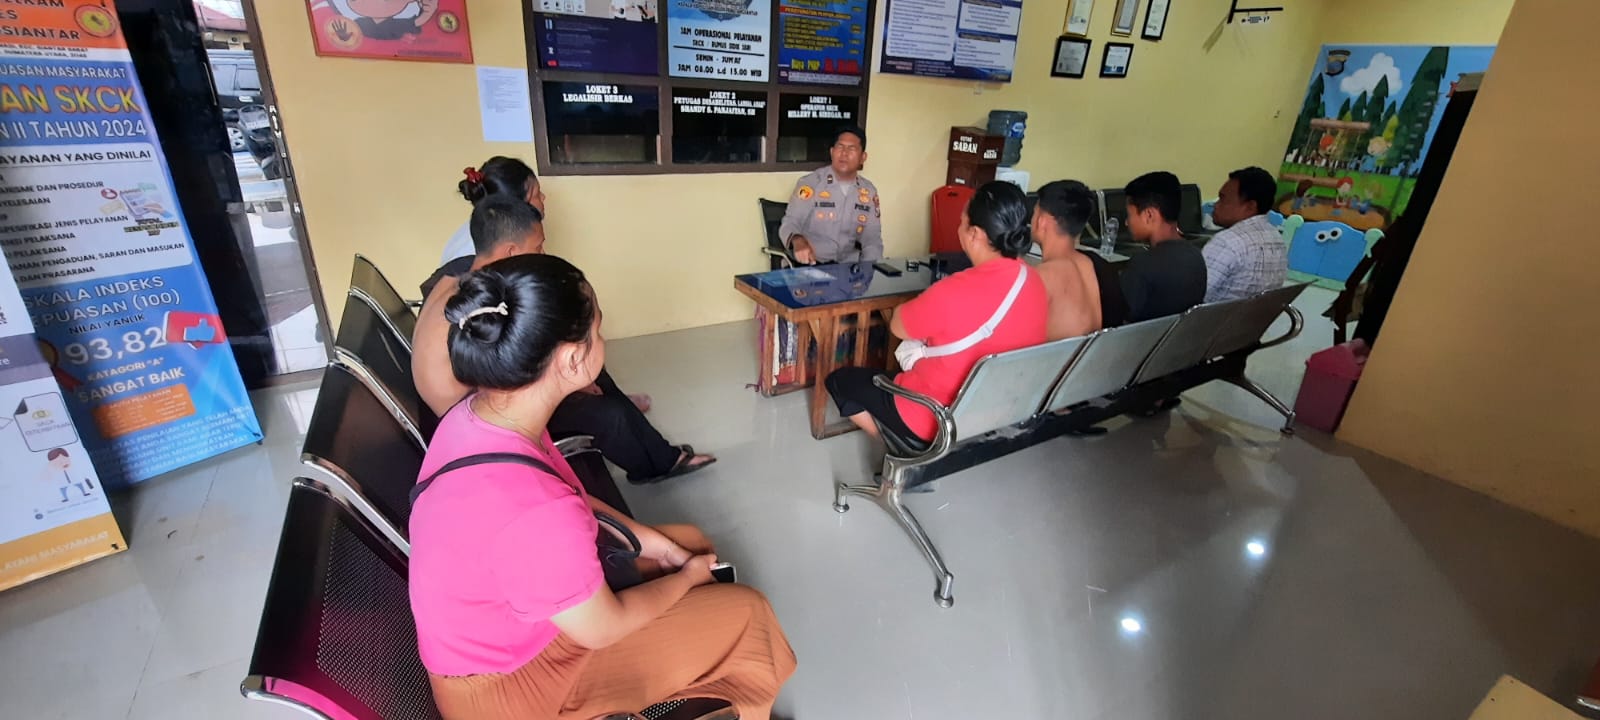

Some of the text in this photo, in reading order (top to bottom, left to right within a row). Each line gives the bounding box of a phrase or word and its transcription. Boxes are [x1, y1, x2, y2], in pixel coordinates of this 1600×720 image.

[680, 26, 691, 36] JAM
[694, 28, 731, 40] OPERASIONAL
[46, 66, 126, 79] MASYARAKAT
[678, 63, 691, 72] JAM
[694, 64, 714, 74] 08.00
[730, 67, 747, 76] 15.00
[751, 69, 762, 77] WIB
[585, 85, 618, 94] LOKET 3
[709, 91, 730, 99] LOKET
[53, 85, 142, 114] SKCK
[563, 93, 633, 104] LEGALISIR BERKAS
[673, 96, 701, 105] PETUGAS
[29, 120, 99, 139] TAHUN
[101, 119, 146, 138] 2024
[952, 141, 978, 153] SARAN
[65, 152, 103, 162] YANG
[106, 150, 151, 161] DINILAI
[36, 183, 57, 192] DAN
[58, 181, 104, 190] PROSEDUR
[55, 220, 78, 229] JENIS
[79, 215, 128, 226] PELAYANAN
[24, 232, 76, 244] PELAKSANA
[14, 245, 67, 257] PELAKSANA
[42, 255, 97, 267] PENGADUAN,
[99, 250, 127, 260] SARAN
[128, 247, 147, 257] DAN
[147, 243, 185, 254] MASUKAN
[42, 266, 95, 279] PRASARANA
[25, 275, 164, 309] SKALA INDEKS
[132, 288, 181, 312] (100)
[69, 313, 145, 336] NILAI YANLIK
[65, 326, 163, 366] 93,82
[87, 362, 145, 383] KATAGORI
[78, 376, 145, 404] SANGAT
[150, 366, 186, 387] BAIK
